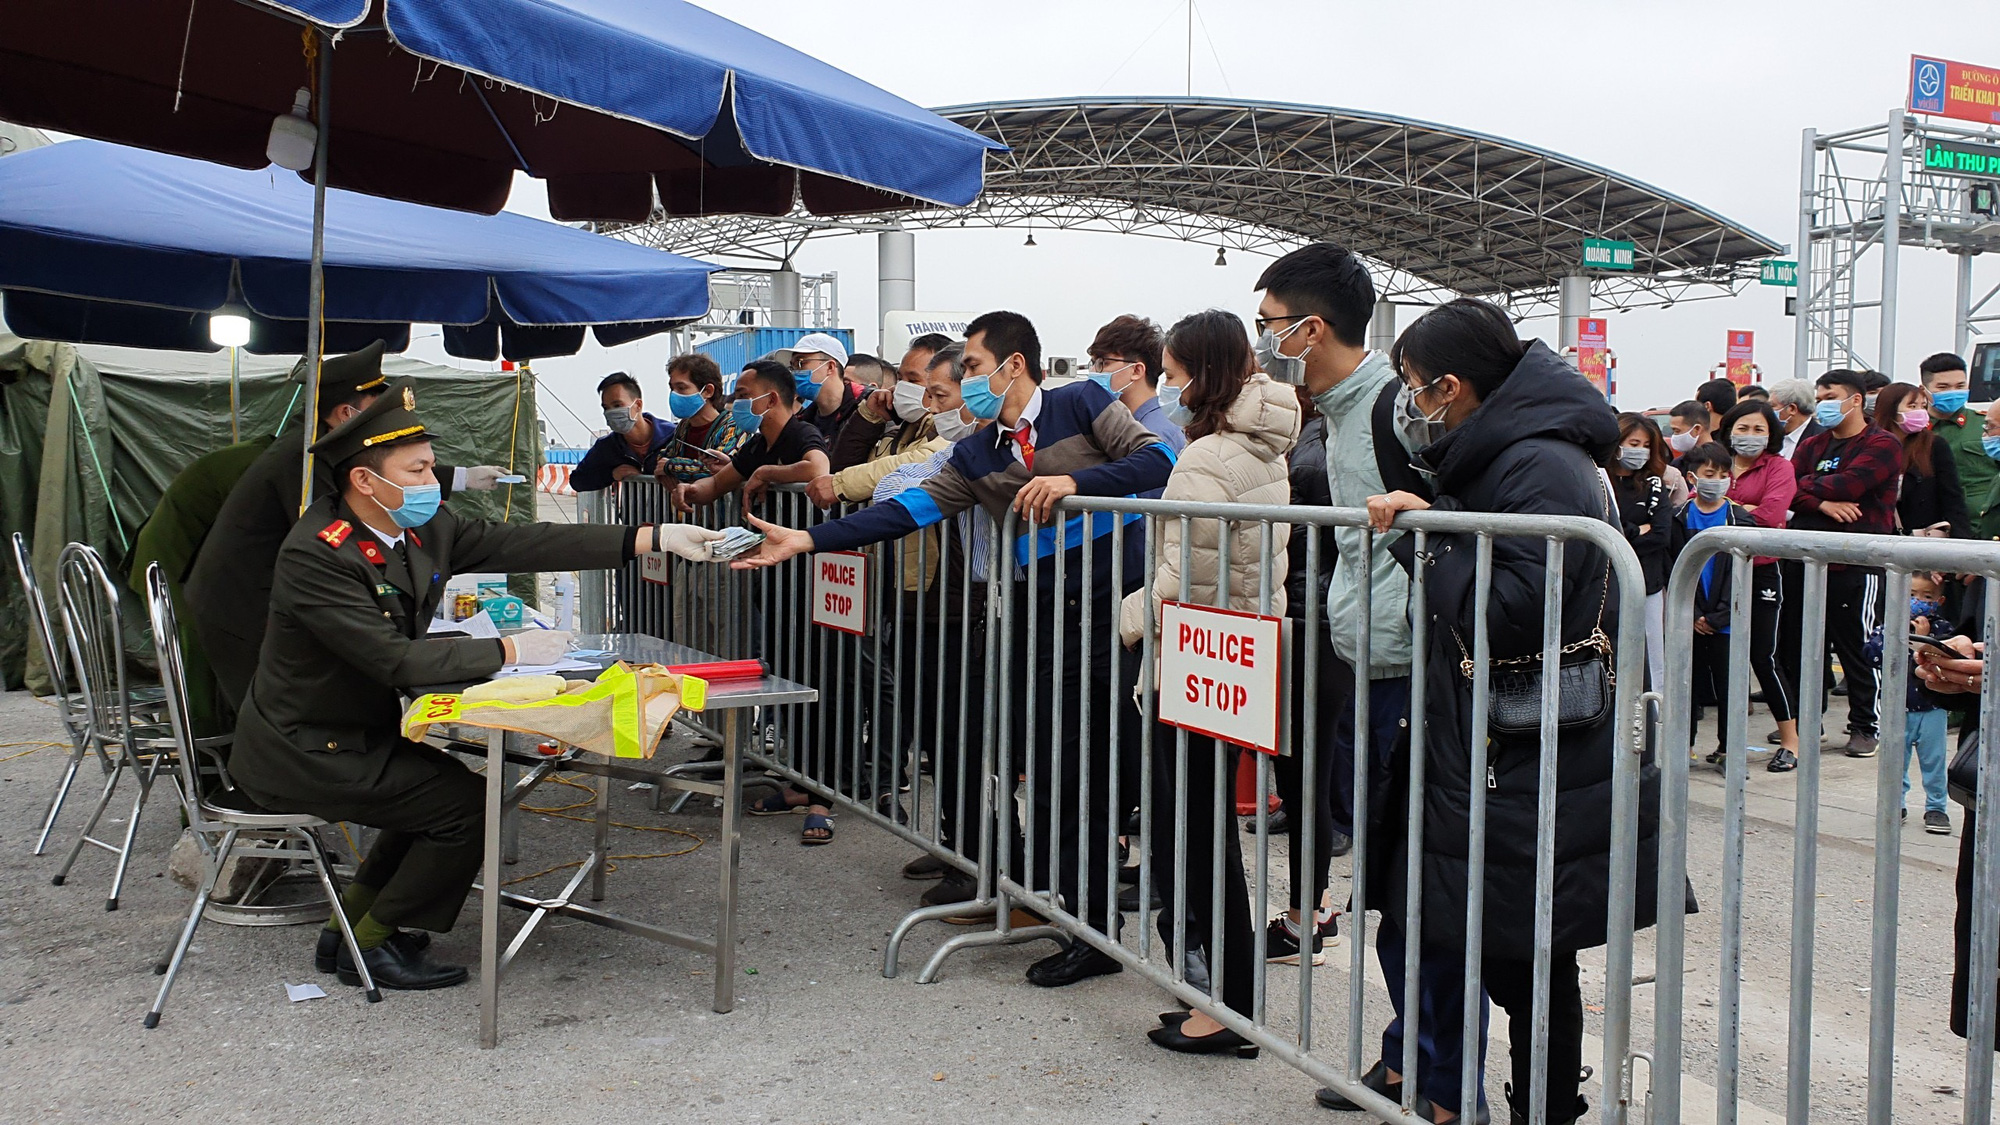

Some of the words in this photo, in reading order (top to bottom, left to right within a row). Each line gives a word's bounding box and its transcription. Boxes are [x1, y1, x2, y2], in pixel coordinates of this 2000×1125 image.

[1950, 82, 1974, 102] TRIỂN
[1976, 89, 1995, 106] KHAI
[1957, 152, 1986, 172] THU
[1585, 242, 1610, 263] QUẢNG
[1614, 249, 1632, 264] NINH
[1763, 262, 1775, 280] HÀ
[1778, 264, 1792, 283] NỘI
[906, 321, 948, 335] THÀNH
[647, 556, 662, 572] STOP
[822, 561, 855, 586] POLICE
[825, 592, 852, 616] STOP
[1179, 622, 1254, 668] POLICE
[1185, 673, 1247, 715] STOP
